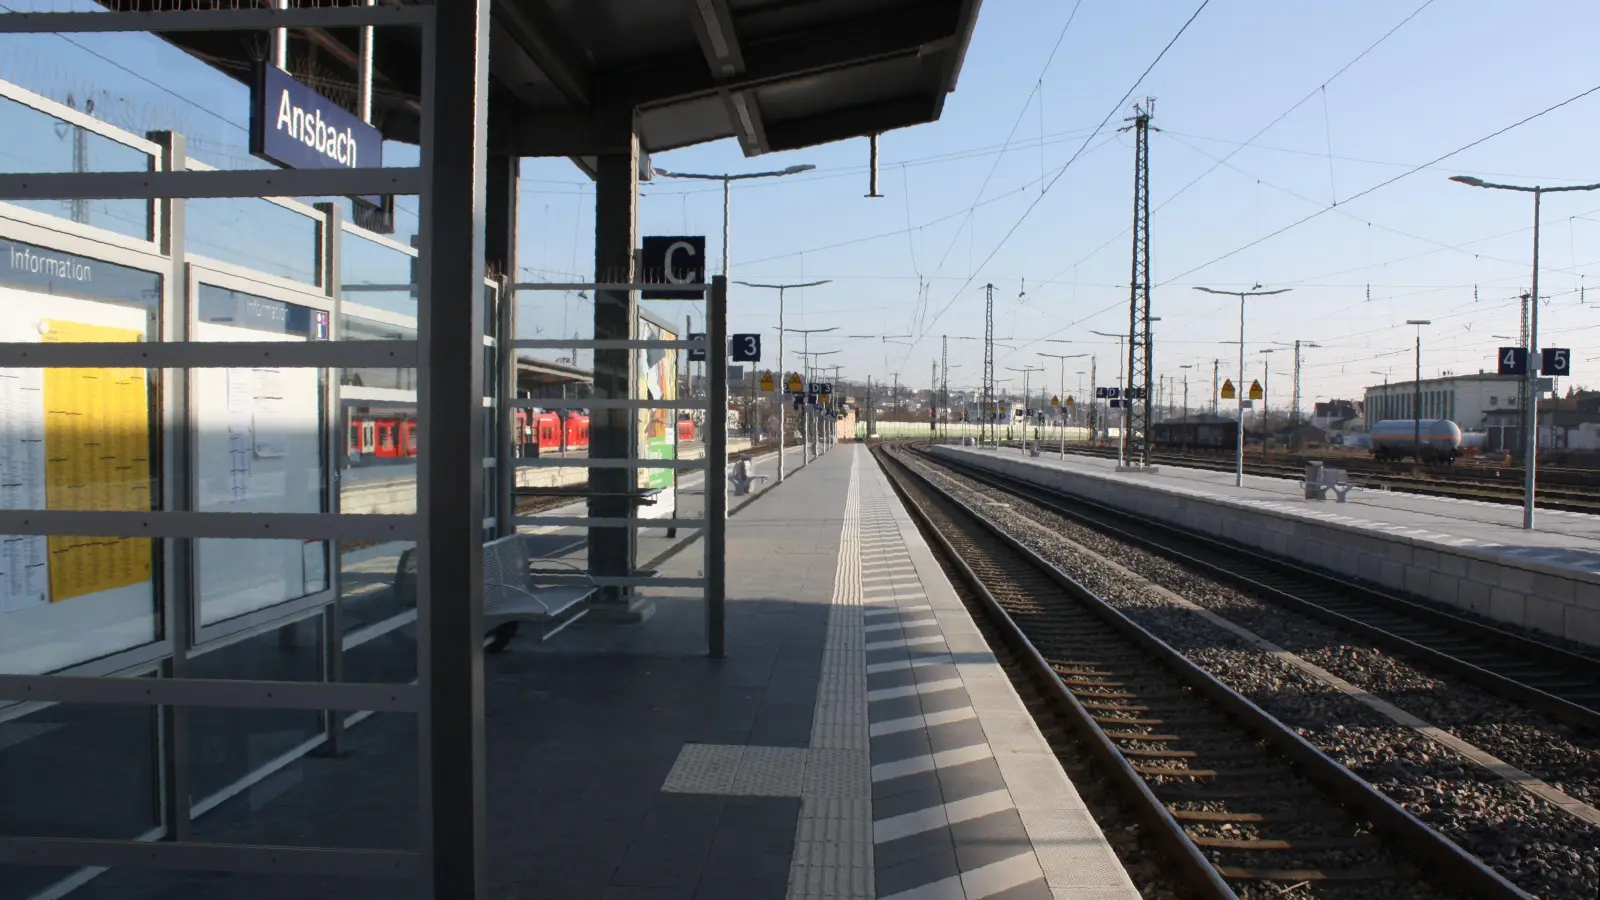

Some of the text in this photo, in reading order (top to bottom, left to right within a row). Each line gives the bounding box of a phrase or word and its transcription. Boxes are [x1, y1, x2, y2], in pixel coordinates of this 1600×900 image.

[277, 88, 357, 168] Ansbach
[10, 246, 91, 282] Information
[664, 241, 696, 286] C
[743, 336, 757, 356] 3
[1503, 349, 1516, 369] 4
[1553, 350, 1566, 370] 5
[812, 383, 831, 393] D 3
[1109, 388, 1116, 397] D
